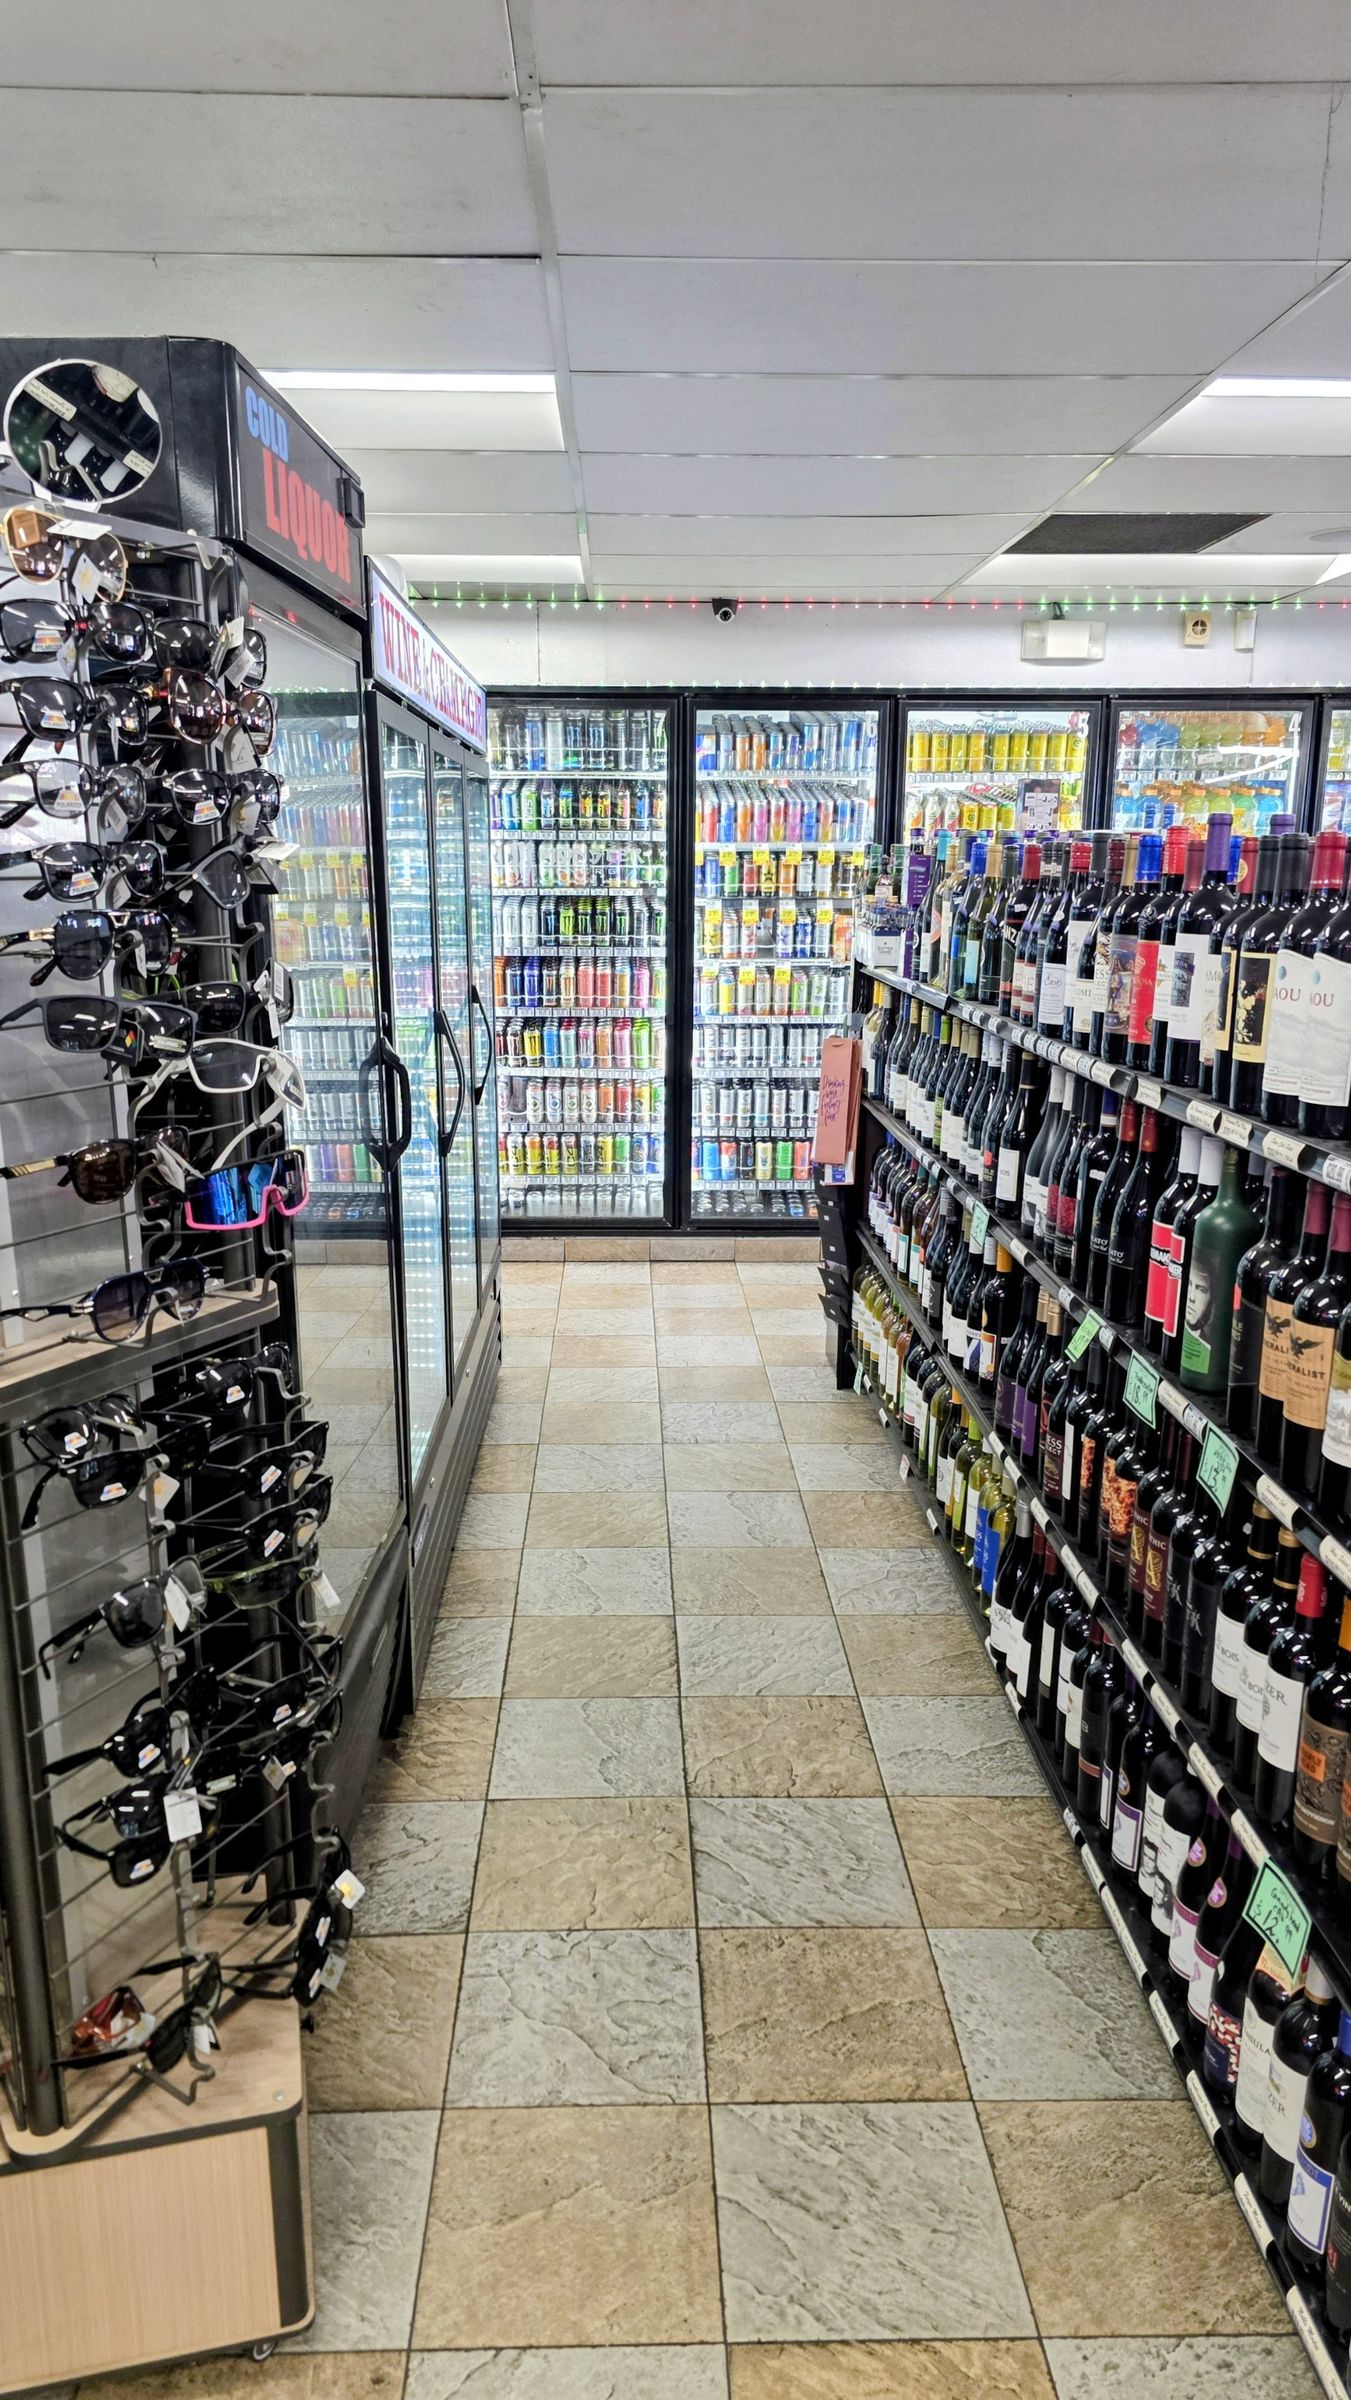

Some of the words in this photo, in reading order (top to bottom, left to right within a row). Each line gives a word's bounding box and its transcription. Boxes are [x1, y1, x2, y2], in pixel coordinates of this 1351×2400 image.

[246, 386, 289, 463] COLD
[262, 447, 351, 584] LIQUOR
[379, 592, 423, 696] WINE
[653, 712, 667, 737] 7
[866, 715, 878, 737] 6
[1077, 711, 1090, 738] 5
[1288, 711, 1302, 740] 4
